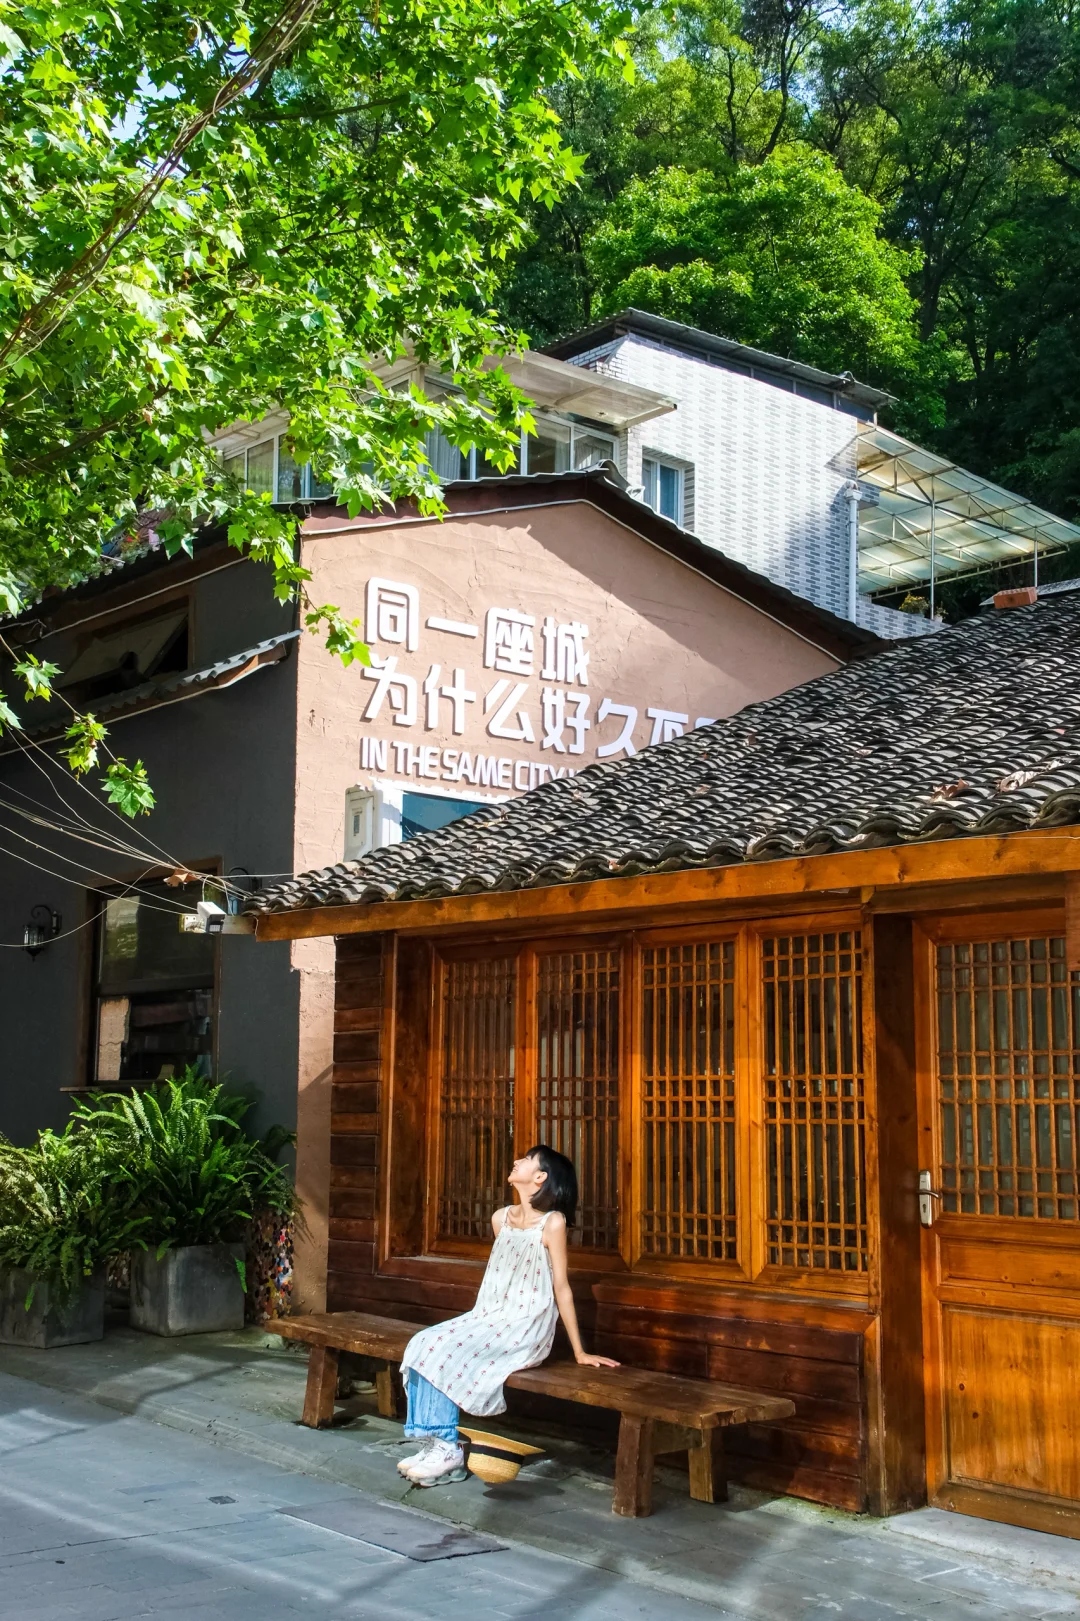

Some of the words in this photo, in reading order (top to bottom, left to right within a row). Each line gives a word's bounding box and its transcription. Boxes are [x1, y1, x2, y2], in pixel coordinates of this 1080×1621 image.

[366, 577, 590, 686] 同一座城
[364, 653, 716, 757] 为什么好久不
[361, 737, 388, 771] IN
[392, 741, 440, 778] THE
[442, 749, 512, 789] SAME
